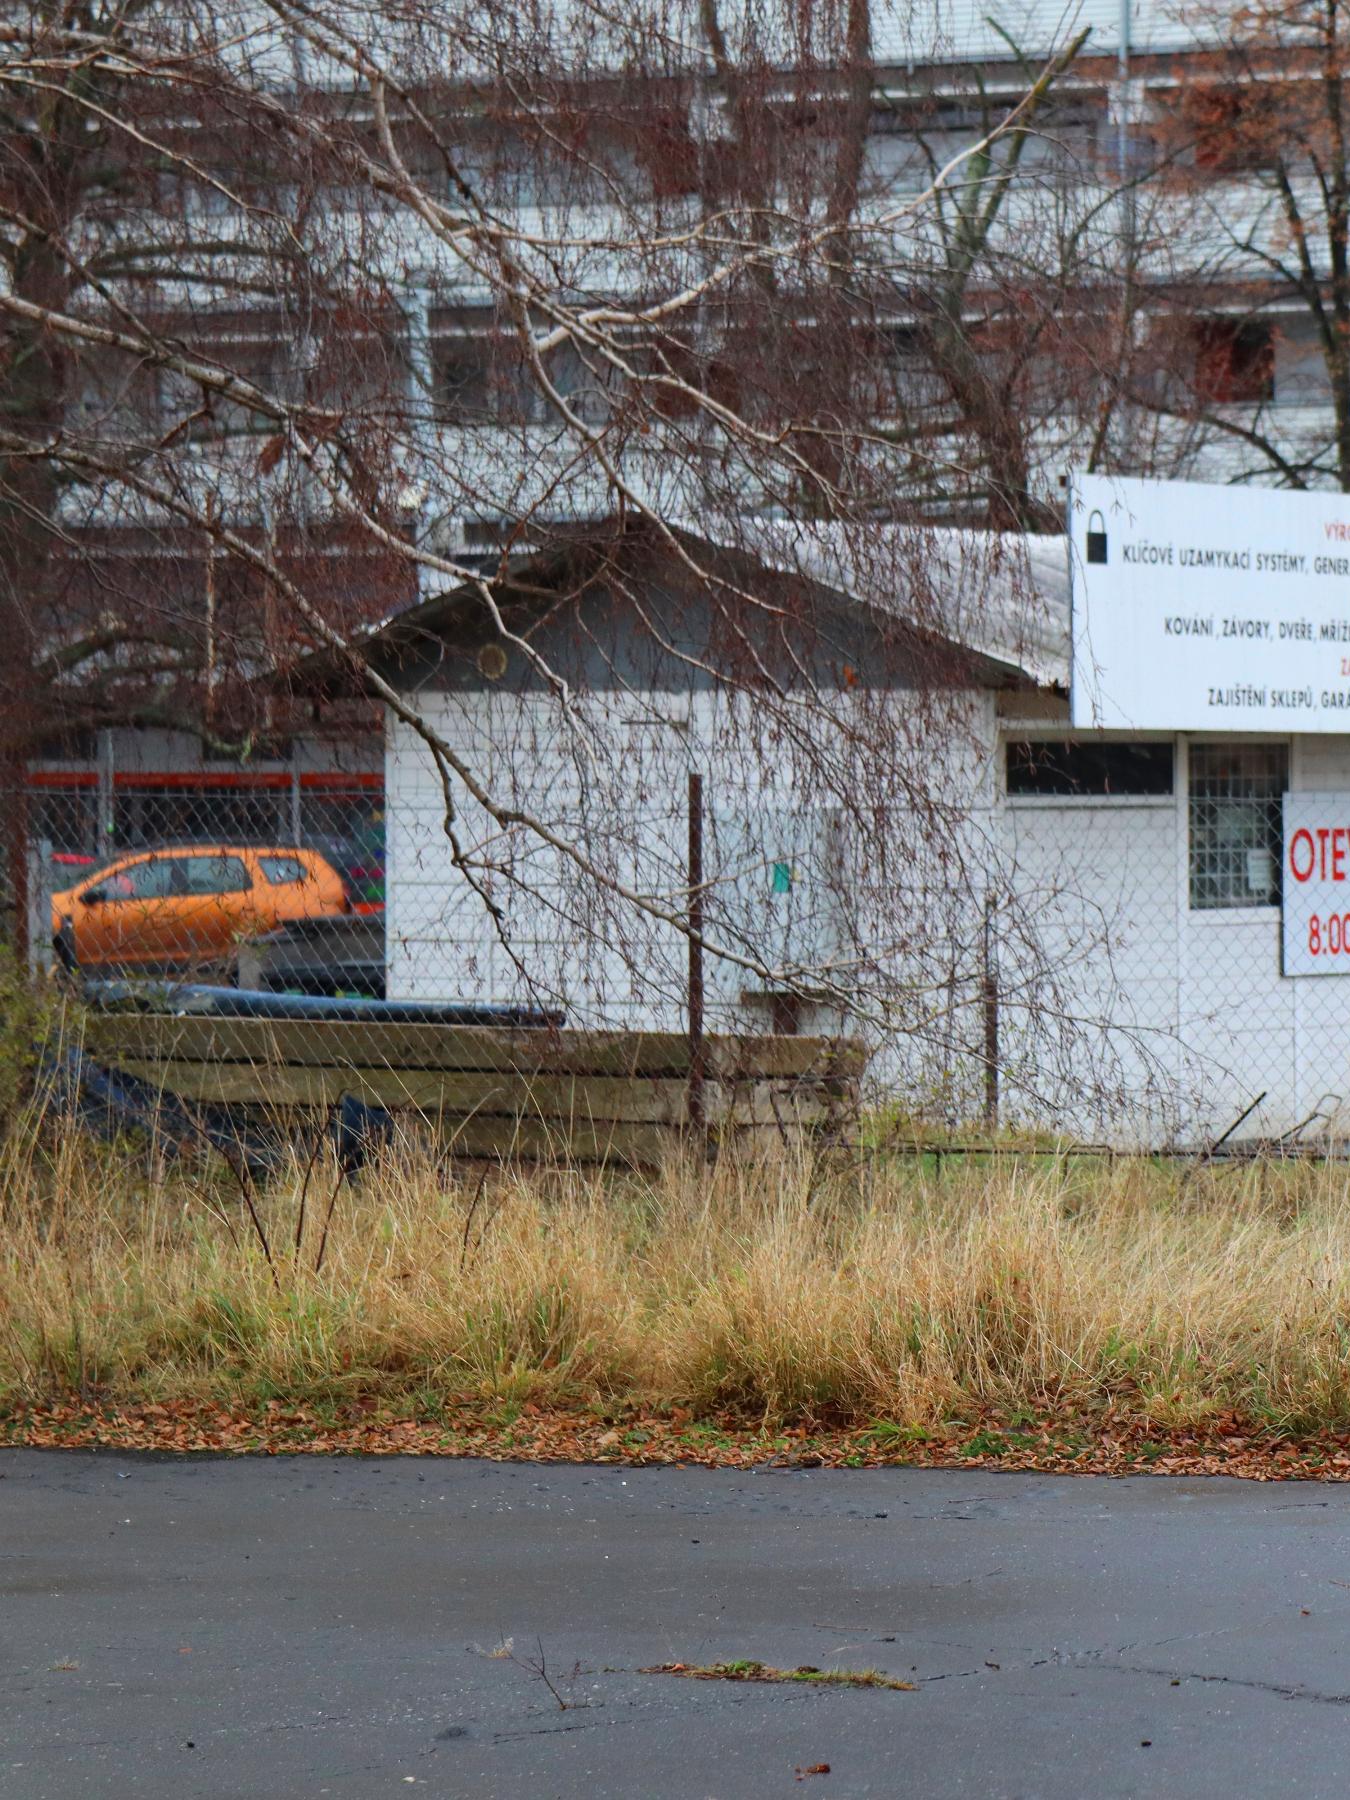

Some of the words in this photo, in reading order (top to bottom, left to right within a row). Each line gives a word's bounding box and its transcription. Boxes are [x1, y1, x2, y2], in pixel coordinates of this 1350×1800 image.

[1122, 540, 1174, 567] KLÍČOVÉ
[1179, 546, 1251, 571] UZAMYKACÍ
[1256, 549, 1309, 574] SYSTÉMY,
[1222, 614, 1275, 643] ZÁVORY,
[1208, 683, 1268, 708] ZAJIŠTĚNÍ
